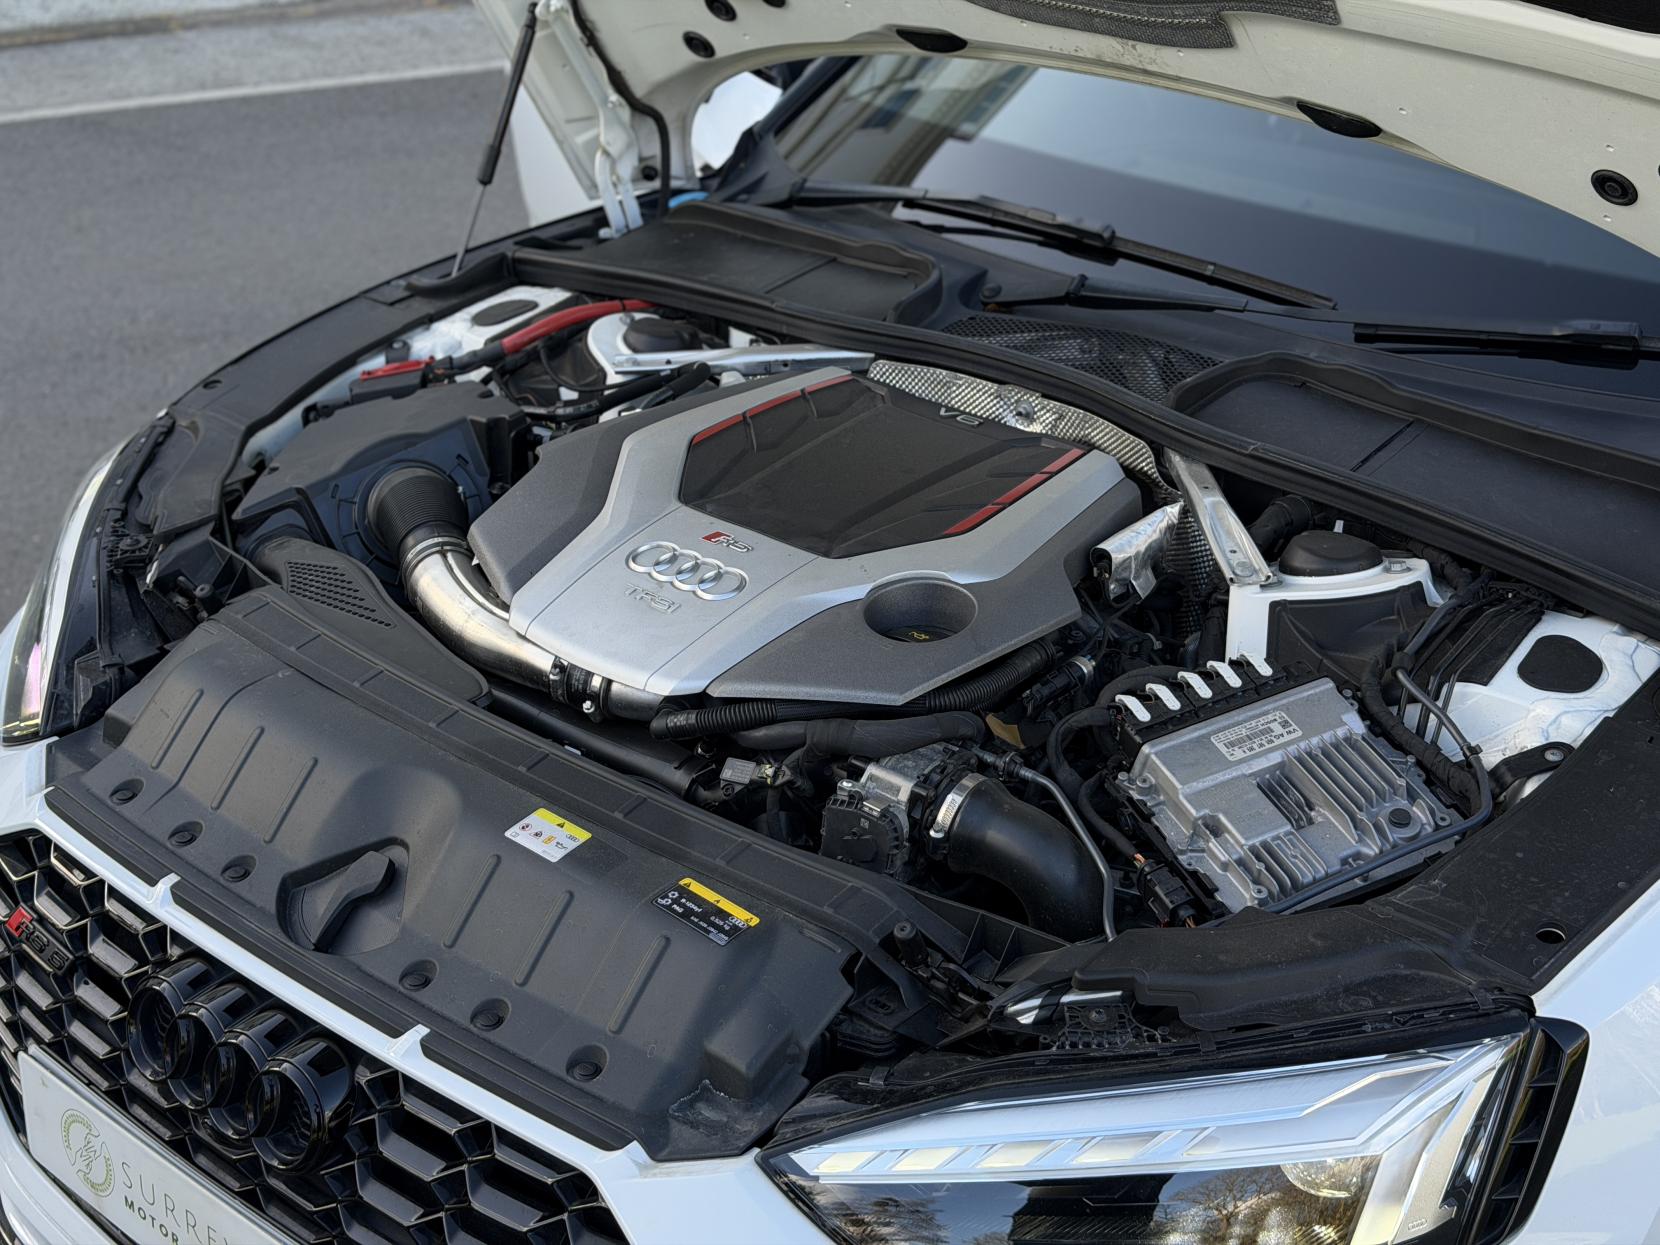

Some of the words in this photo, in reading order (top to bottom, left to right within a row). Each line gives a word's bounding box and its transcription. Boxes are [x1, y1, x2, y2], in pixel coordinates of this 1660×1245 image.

[939, 406, 984, 428] V6
[703, 531, 754, 553] RS
[624, 583, 681, 614] TFSI
[1285, 728, 1299, 736] VW
[47, 948, 69, 971] 5
[121, 1161, 228, 1245] SURRE
[124, 1194, 179, 1245] MOTOR
